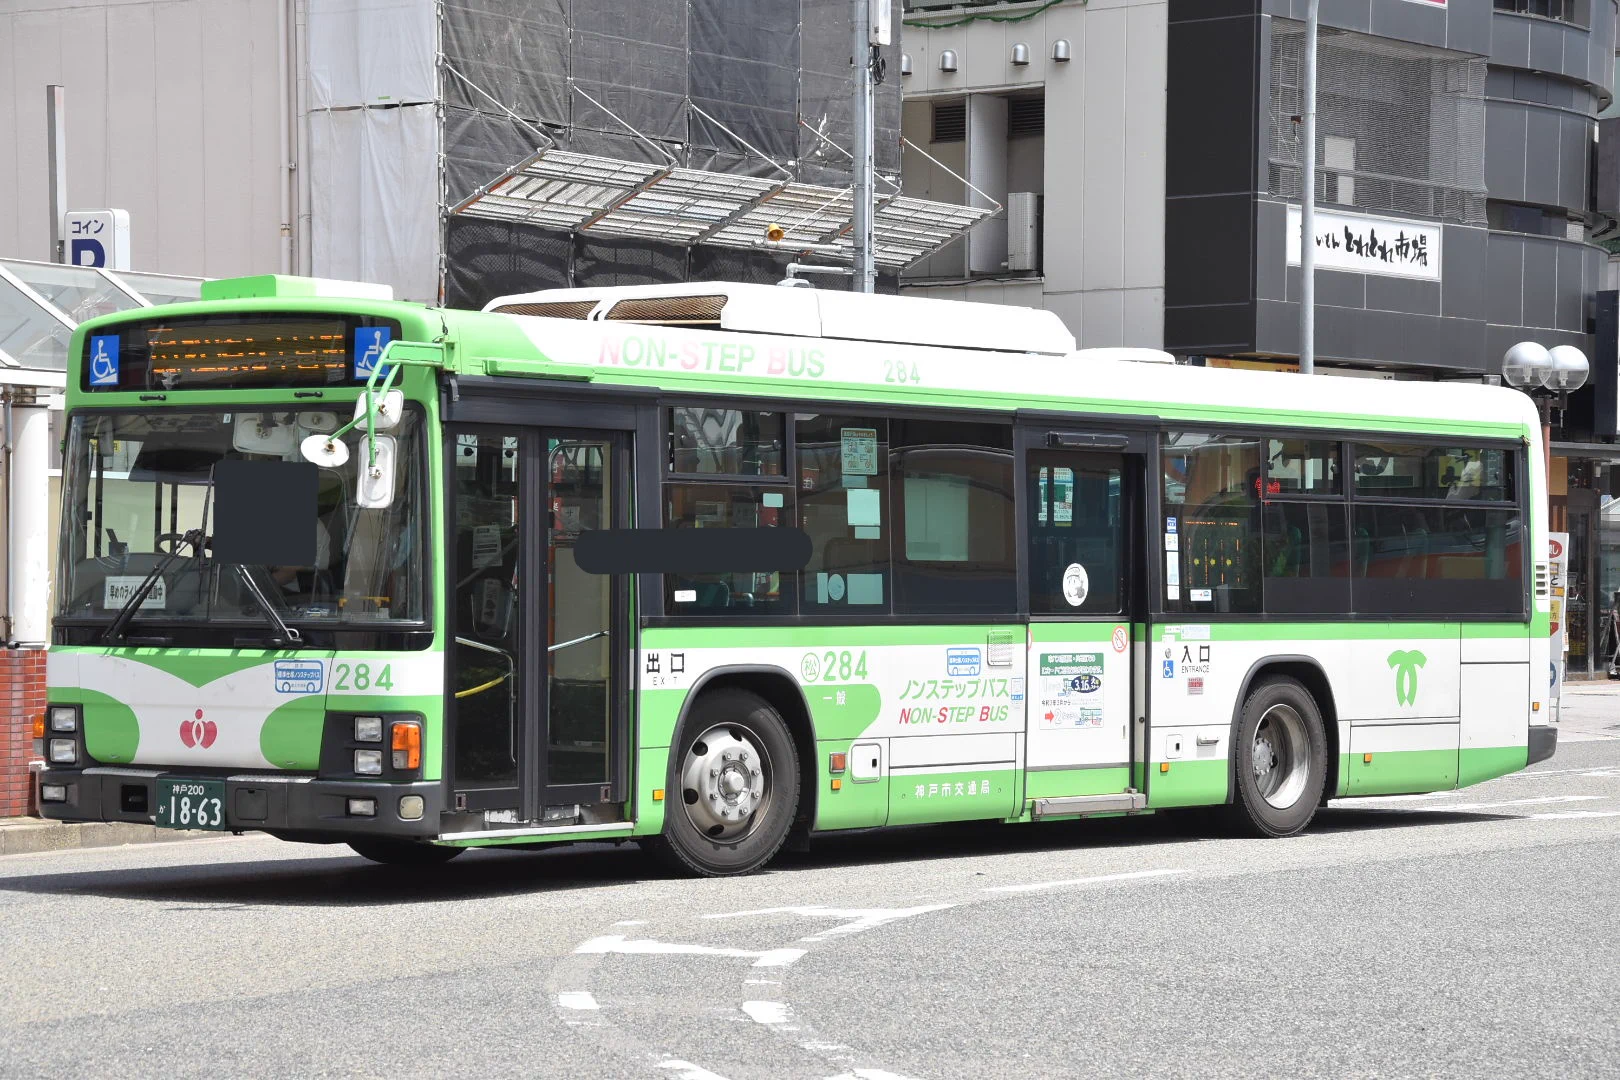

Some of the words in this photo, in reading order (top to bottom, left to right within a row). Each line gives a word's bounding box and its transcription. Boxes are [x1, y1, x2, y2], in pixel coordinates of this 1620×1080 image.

[72, 220, 104, 234] コイン
[599, 336, 755, 372] NON-STEP
[767, 348, 825, 378] BUS
[884, 360, 921, 385] 284
[646, 652, 685, 674] 出口
[1181, 645, 1210, 663] 入口
[823, 649, 868, 681] 284
[1181, 665, 1210, 673] ENTRANCE
[335, 663, 394, 691] 284
[653, 676, 677, 686] EXT
[823, 689, 846, 705] 一般
[899, 678, 1009, 700] ノンステップバス
[899, 706, 976, 724] NON-STEP
[980, 705, 1008, 722] BUS
[172, 784, 204, 796] 神戸200
[915, 780, 990, 799] 神戸市交通局
[159, 805, 166, 814] か
[170, 795, 221, 826] 18-63
